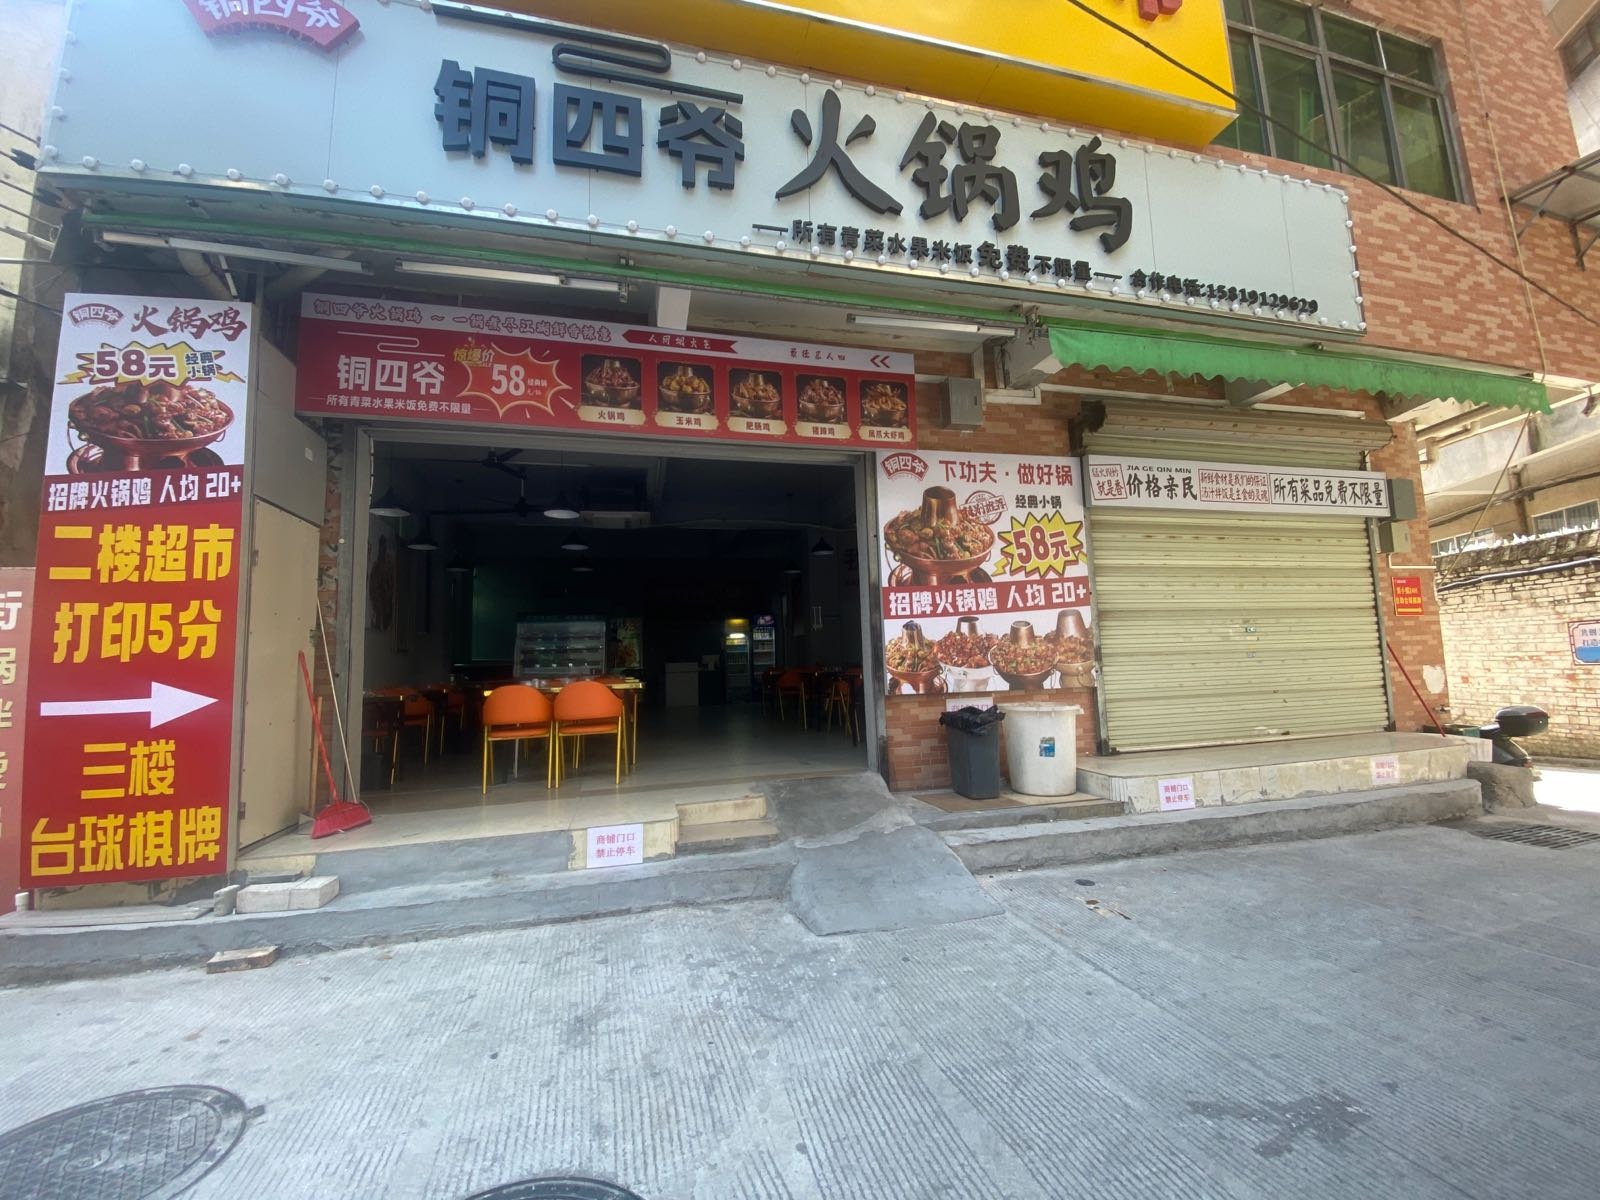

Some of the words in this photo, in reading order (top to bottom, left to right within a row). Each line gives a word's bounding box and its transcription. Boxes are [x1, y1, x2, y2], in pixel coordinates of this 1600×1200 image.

[434, 59, 745, 190] 铜四爷
[775, 88, 1132, 253] 火锅鸡
[791, 219, 1092, 281] 所有青菜水果米饭免费不限量
[71, 306, 120, 321] 铜四爷
[131, 304, 248, 342] 火锅鸡
[313, 298, 423, 324] 铜四爷火锅鸡
[96, 348, 177, 379] 58元
[185, 352, 214, 365] 经典
[187, 364, 217, 378] 小锅
[336, 354, 446, 395] 铜四爷
[490, 363, 526, 397] 58
[326, 394, 472, 415] 所有青菜水果米饭免费不限量
[598, 409, 626, 422] 火锅鸡
[884, 455, 926, 474] 铜四爷
[1127, 464, 1139, 472] JIA
[1142, 465, 1154, 473] GE
[47, 477, 153, 512] 招牌火锅鸡
[159, 474, 200, 504] 人均
[205, 471, 242, 499] 20+
[1096, 479, 1124, 497] 就是香
[1126, 472, 1198, 501] 价格亲民
[1273, 477, 1384, 507] 所有菜品免费不限量
[1015, 494, 1063, 510] 经典小锅
[48, 523, 235, 584] 二楼超市
[1012, 525, 1071, 566] 58元
[888, 587, 999, 617] 招牌火锅鸡
[1006, 584, 1046, 609] 人均
[1051, 581, 1087, 604] 20+
[53, 600, 222, 664] 打印5分
[80, 739, 177, 800] 三楼
[31, 806, 222, 877] 台球棋牌
[596, 832, 635, 845] 商铺门口
[596, 846, 636, 859] 禁止停车
